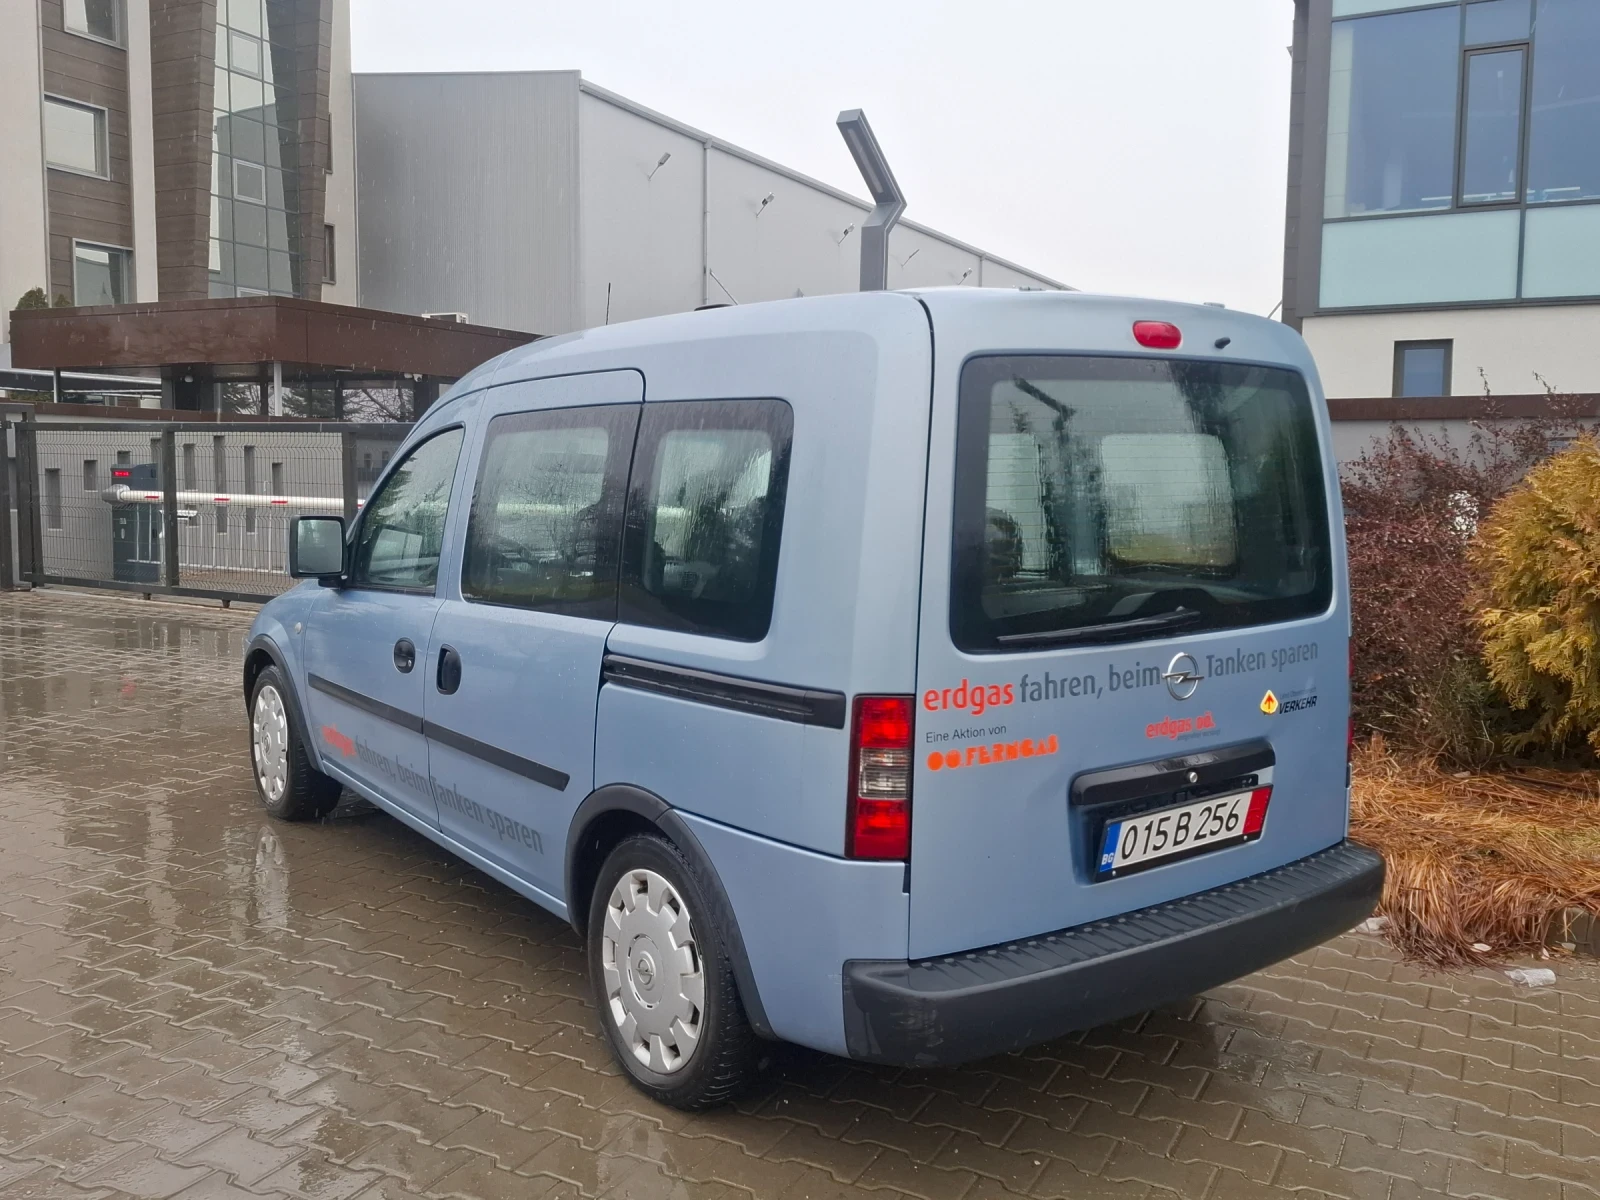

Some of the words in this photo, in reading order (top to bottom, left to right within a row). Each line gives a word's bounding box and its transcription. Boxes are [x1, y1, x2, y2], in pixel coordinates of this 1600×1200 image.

[923, 678, 1014, 716] erdgas
[1020, 672, 1104, 703] fahren,
[1108, 661, 1160, 692] beim
[1206, 648, 1265, 678] Tanken
[1271, 642, 1318, 672] sparen
[1279, 696, 1317, 714] VERKEHR
[926, 732, 949, 743] Eine
[952, 727, 985, 740] Aktion
[988, 725, 1007, 736] von
[1146, 716, 1191, 739] erdgas
[396, 754, 430, 796] beim
[430, 776, 484, 825] Tanken
[486, 808, 544, 855] sparen
[1102, 853, 1114, 865] BG
